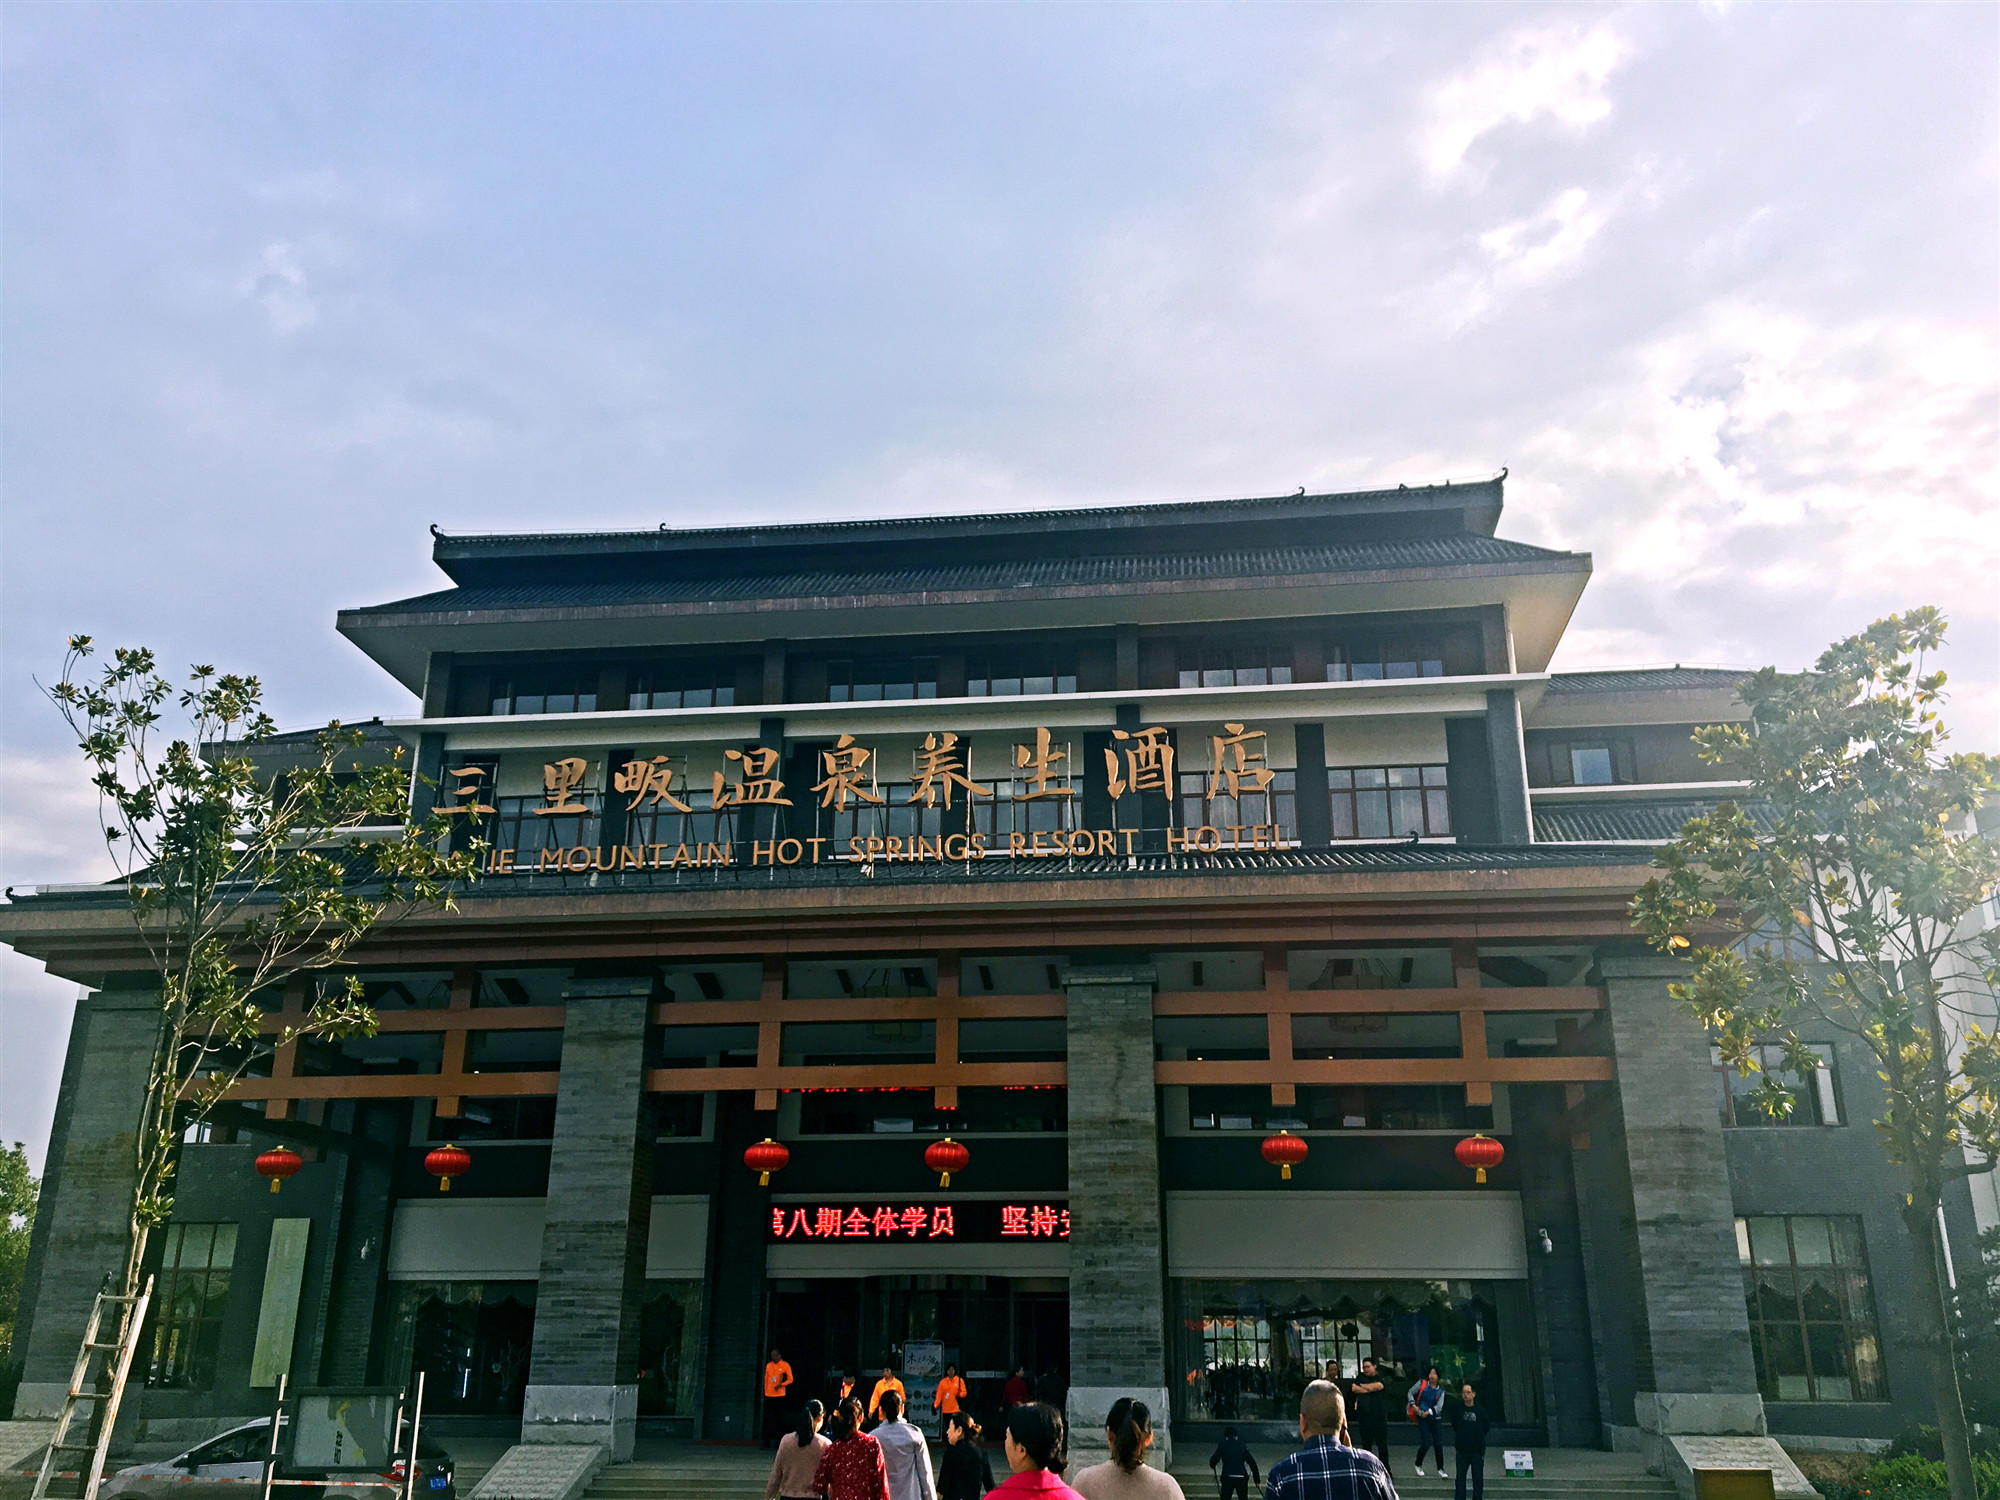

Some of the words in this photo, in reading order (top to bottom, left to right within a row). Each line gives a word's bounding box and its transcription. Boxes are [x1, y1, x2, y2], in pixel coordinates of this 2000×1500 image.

[431, 722, 1276, 815] 三里畈温泉养生酒店
[539, 841, 731, 873] MOUNTAIN
[752, 837, 826, 866] HOT
[849, 833, 987, 863] SPRINGS
[1009, 828, 1140, 858] RESORT
[1166, 824, 1292, 854] HOTEL
